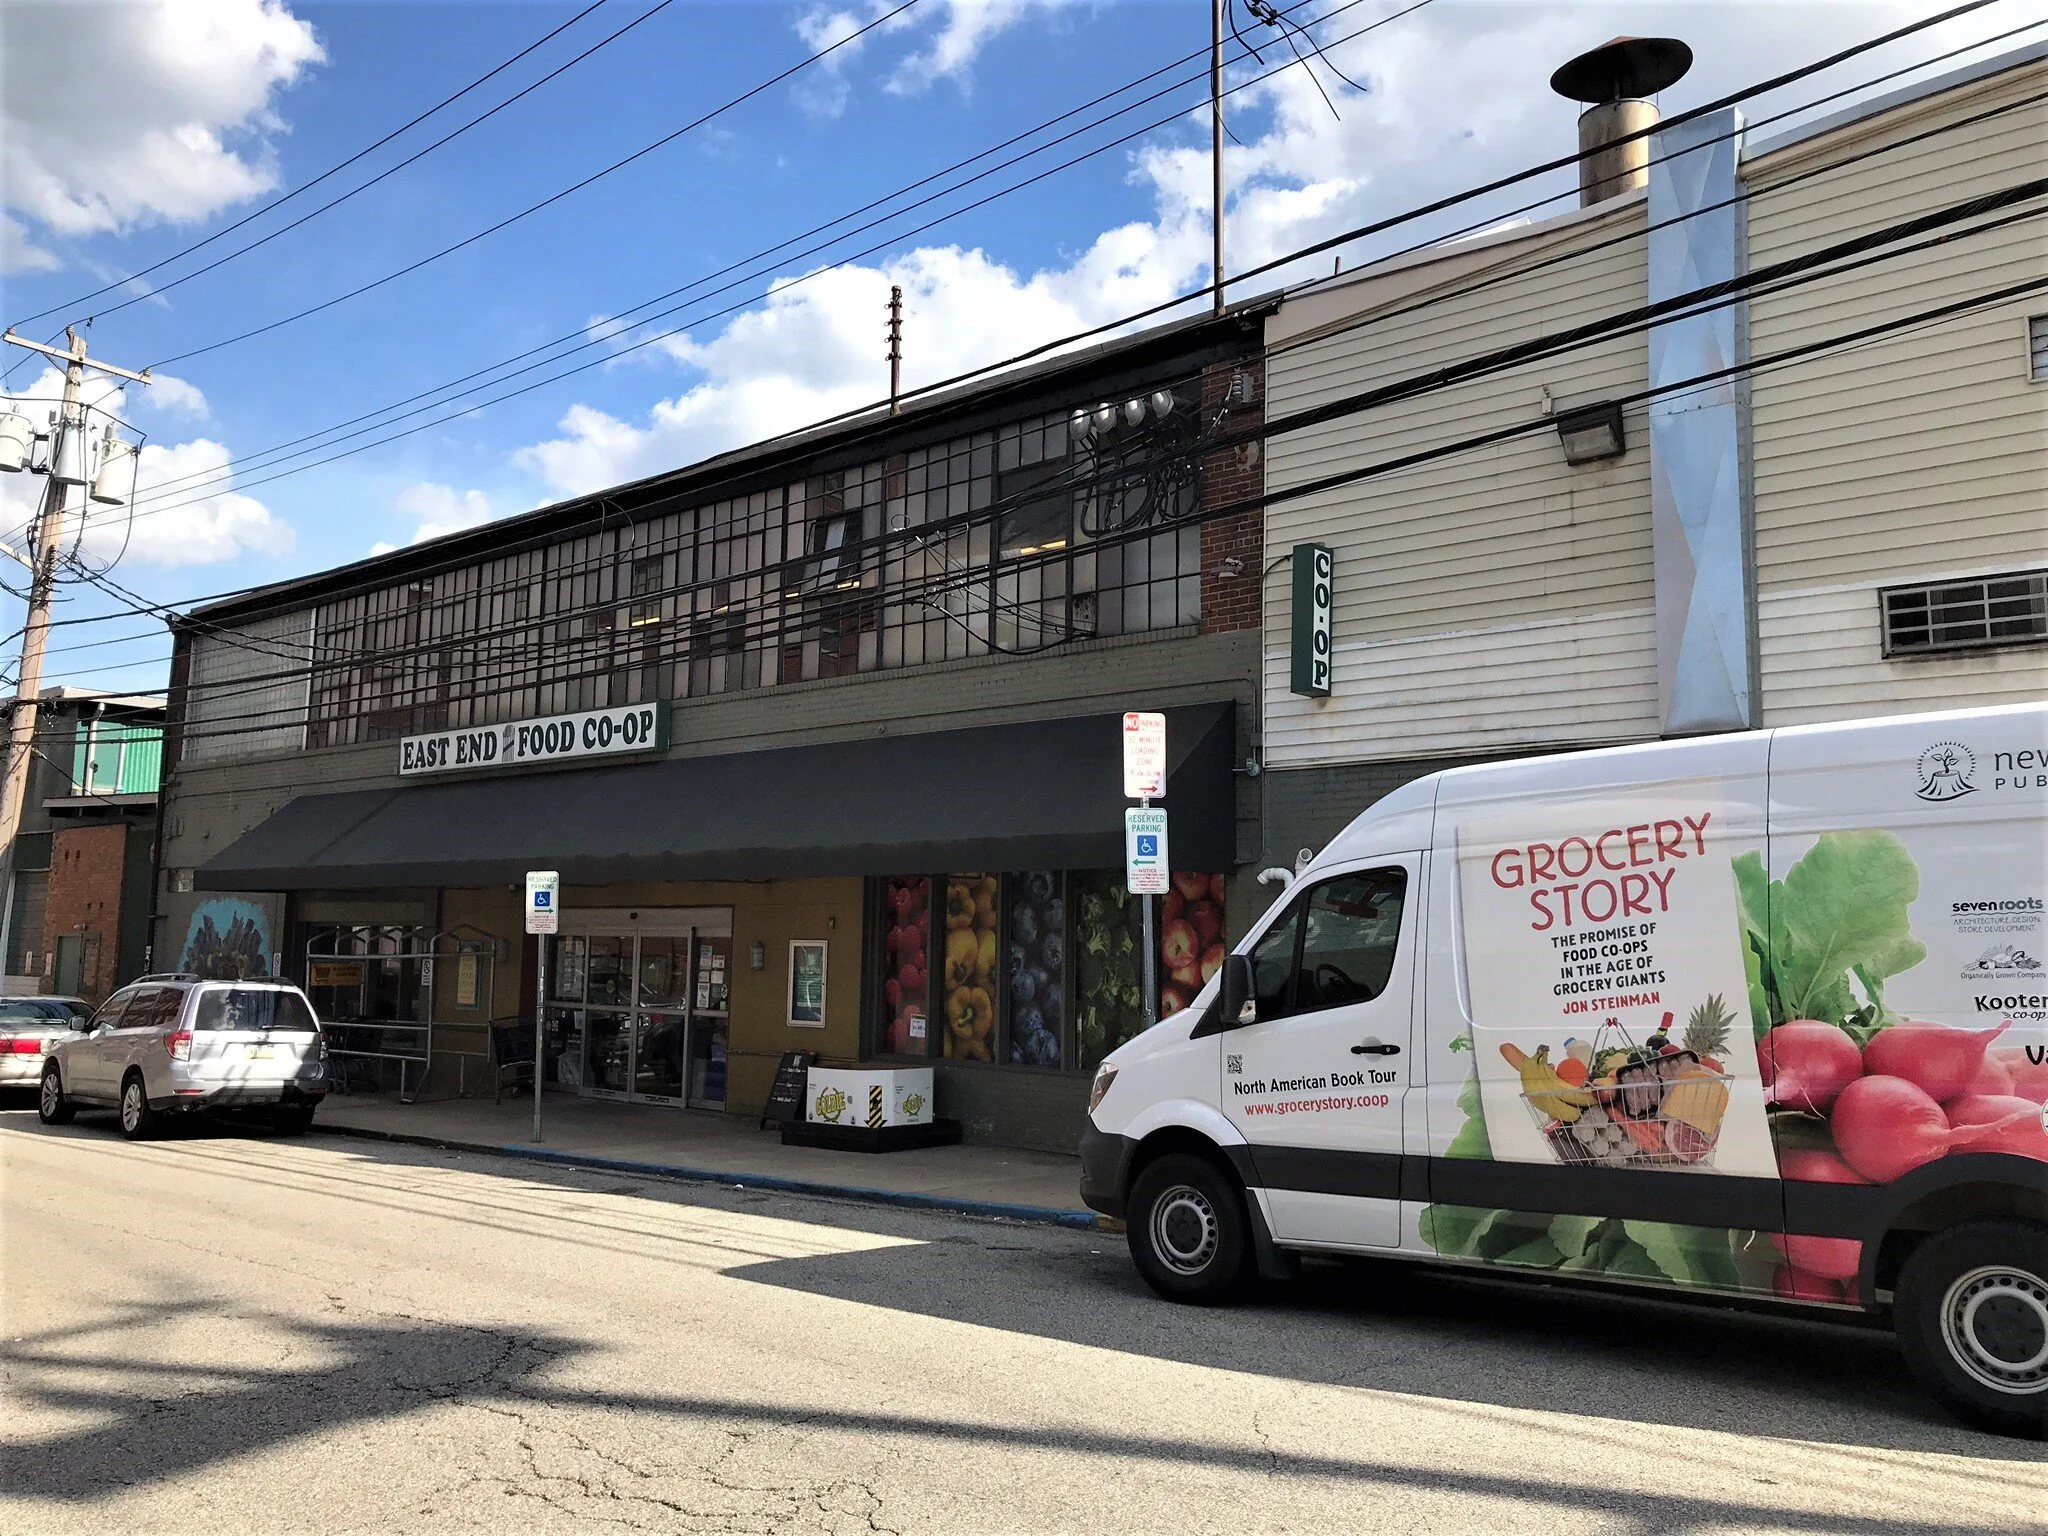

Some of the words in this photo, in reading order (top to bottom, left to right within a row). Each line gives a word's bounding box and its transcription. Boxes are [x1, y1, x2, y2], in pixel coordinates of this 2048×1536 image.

[1314, 553, 1330, 686] CO-OP
[1125, 716, 1138, 729] NO
[1139, 719, 1163, 728] PARKING
[402, 736, 450, 770] EAST
[455, 730, 498, 765] END
[517, 720, 576, 757] FOOD
[582, 709, 654, 750] CO-OP
[1136, 757, 1153, 766] ZONE
[1128, 814, 1165, 823] RESERVED
[1131, 824, 1162, 833] PARKING
[1491, 811, 1712, 889] GROCERY
[1530, 867, 1676, 931] STORY
[1551, 934, 1577, 948] THE
[1579, 925, 1637, 945] PROMISE
[1639, 922, 1657, 936] OF
[1563, 947, 1598, 963] FOOD
[1601, 940, 1648, 957] CO-OPS
[1561, 966, 1574, 979] IN
[1576, 962, 1603, 977] THE
[1606, 958, 1634, 973] AGE
[1636, 955, 1653, 969] OF
[1960, 971, 1994, 980] Organically
[1995, 971, 2016, 979] Grown
[2016, 971, 2047, 980] Company
[1553, 977, 1612, 996] GROCERY
[1616, 970, 1666, 988] GIANTS
[1563, 1000, 1588, 1015] JON
[1591, 991, 1661, 1011] STEINMAN
[2012, 1011, 2047, 1021] co-op
[2025, 1045, 2048, 1066] V
[1234, 1079, 1266, 1096] North
[1270, 1075, 1327, 1093] American
[1331, 1071, 1365, 1088] Book
[1367, 1069, 1397, 1084] Tour
[1244, 1094, 1389, 1116] www.grocerystory.coop
